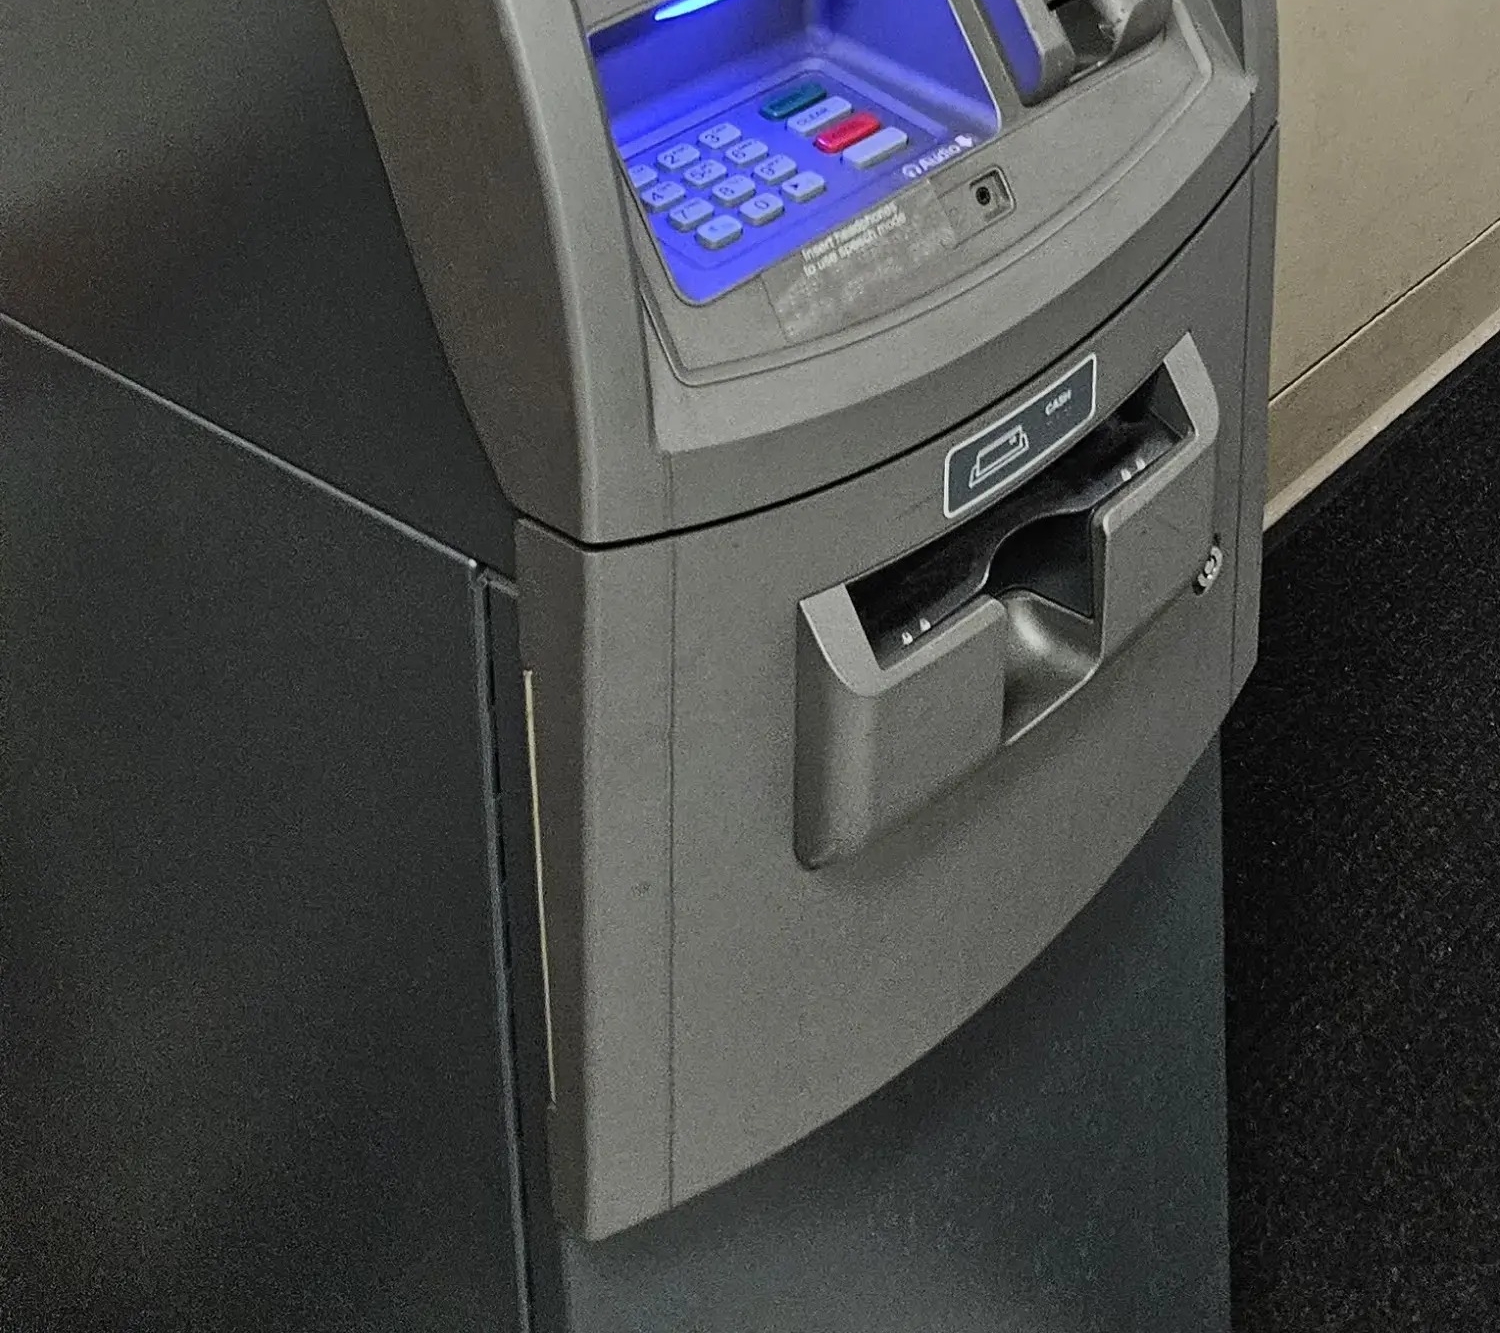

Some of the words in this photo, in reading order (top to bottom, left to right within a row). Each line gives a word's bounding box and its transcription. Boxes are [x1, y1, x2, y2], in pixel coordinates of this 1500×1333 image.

[801, 233, 835, 262] Insert
[803, 264, 817, 278] to
[815, 249, 839, 268] use
[837, 223, 878, 259] speech
[875, 210, 908, 234] mode
[1044, 389, 1073, 417] CASH
